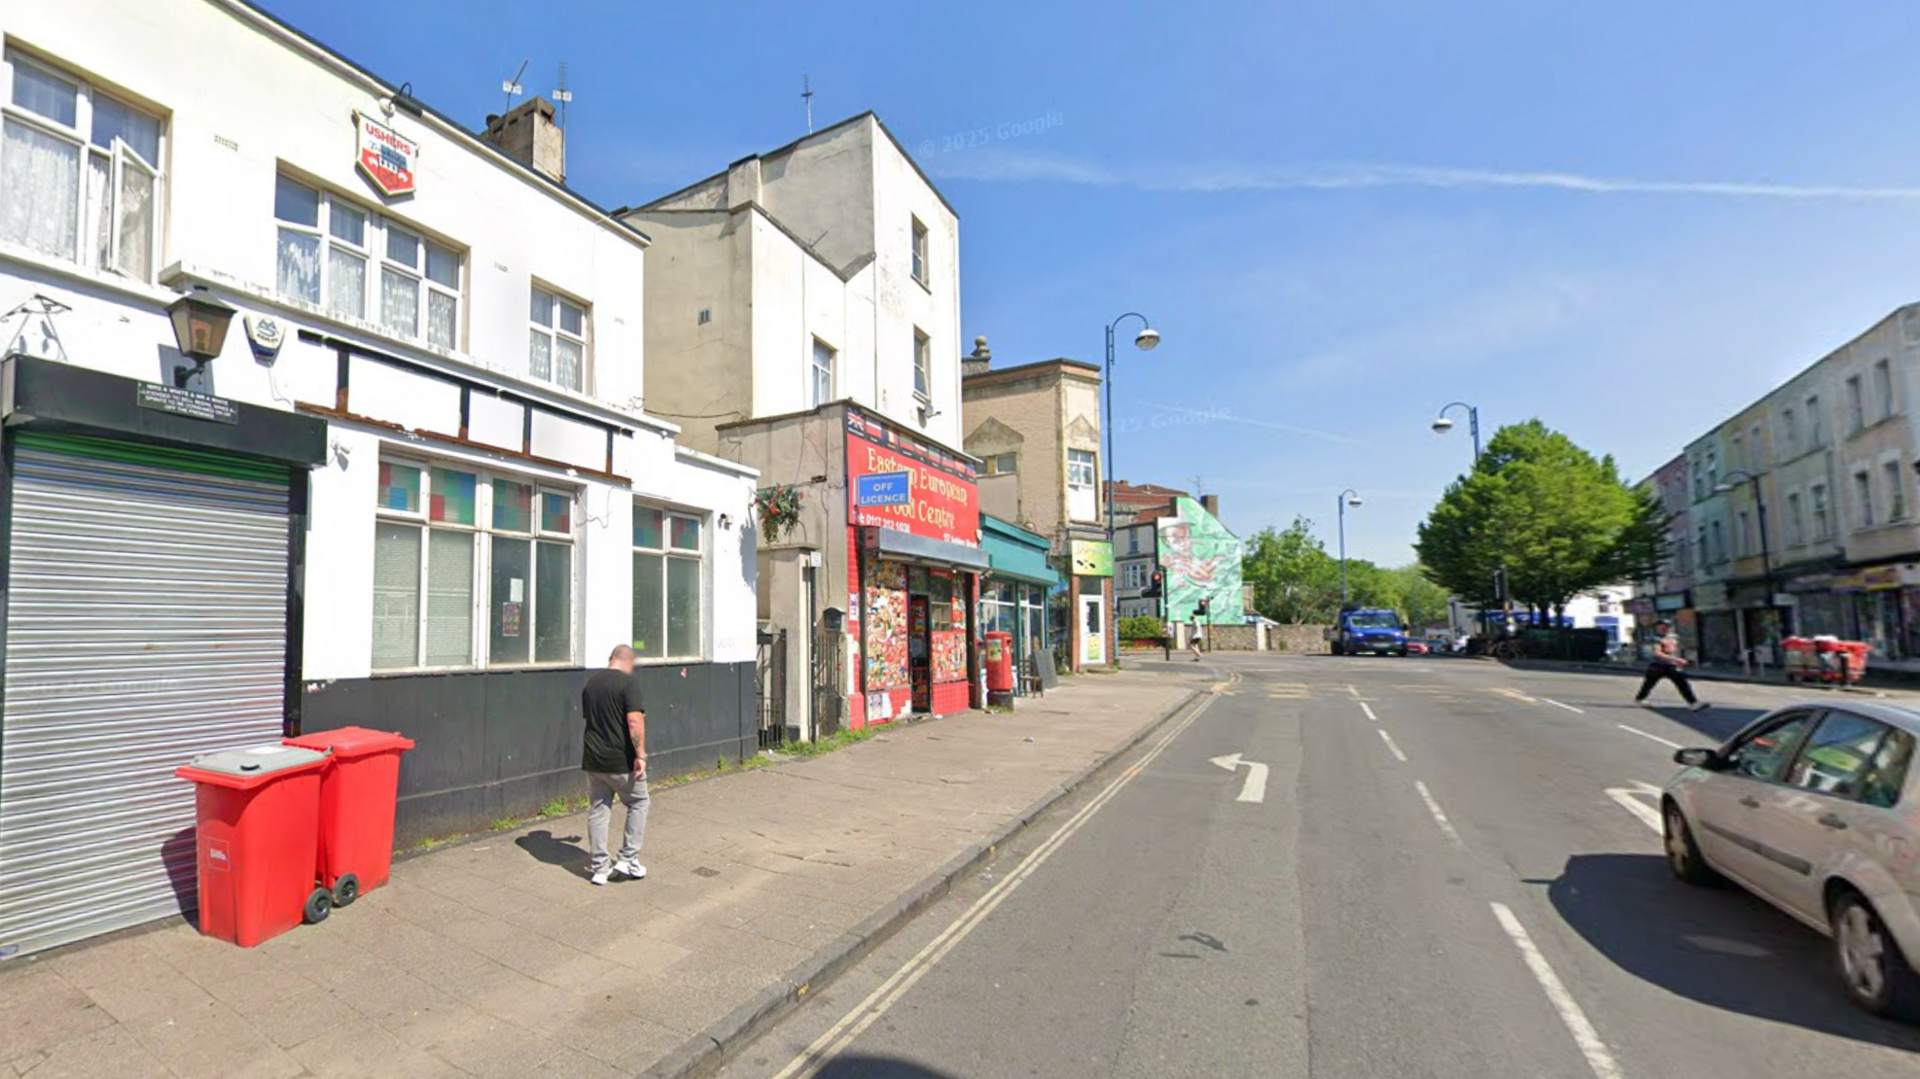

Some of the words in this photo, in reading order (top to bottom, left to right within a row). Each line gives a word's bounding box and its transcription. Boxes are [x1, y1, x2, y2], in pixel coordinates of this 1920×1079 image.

[365, 121, 411, 156] USHERS
[860, 492, 906, 505] LICENCE
[873, 481, 893, 492] OFF
[920, 466, 968, 507] European
[918, 500, 955, 530] Centre
